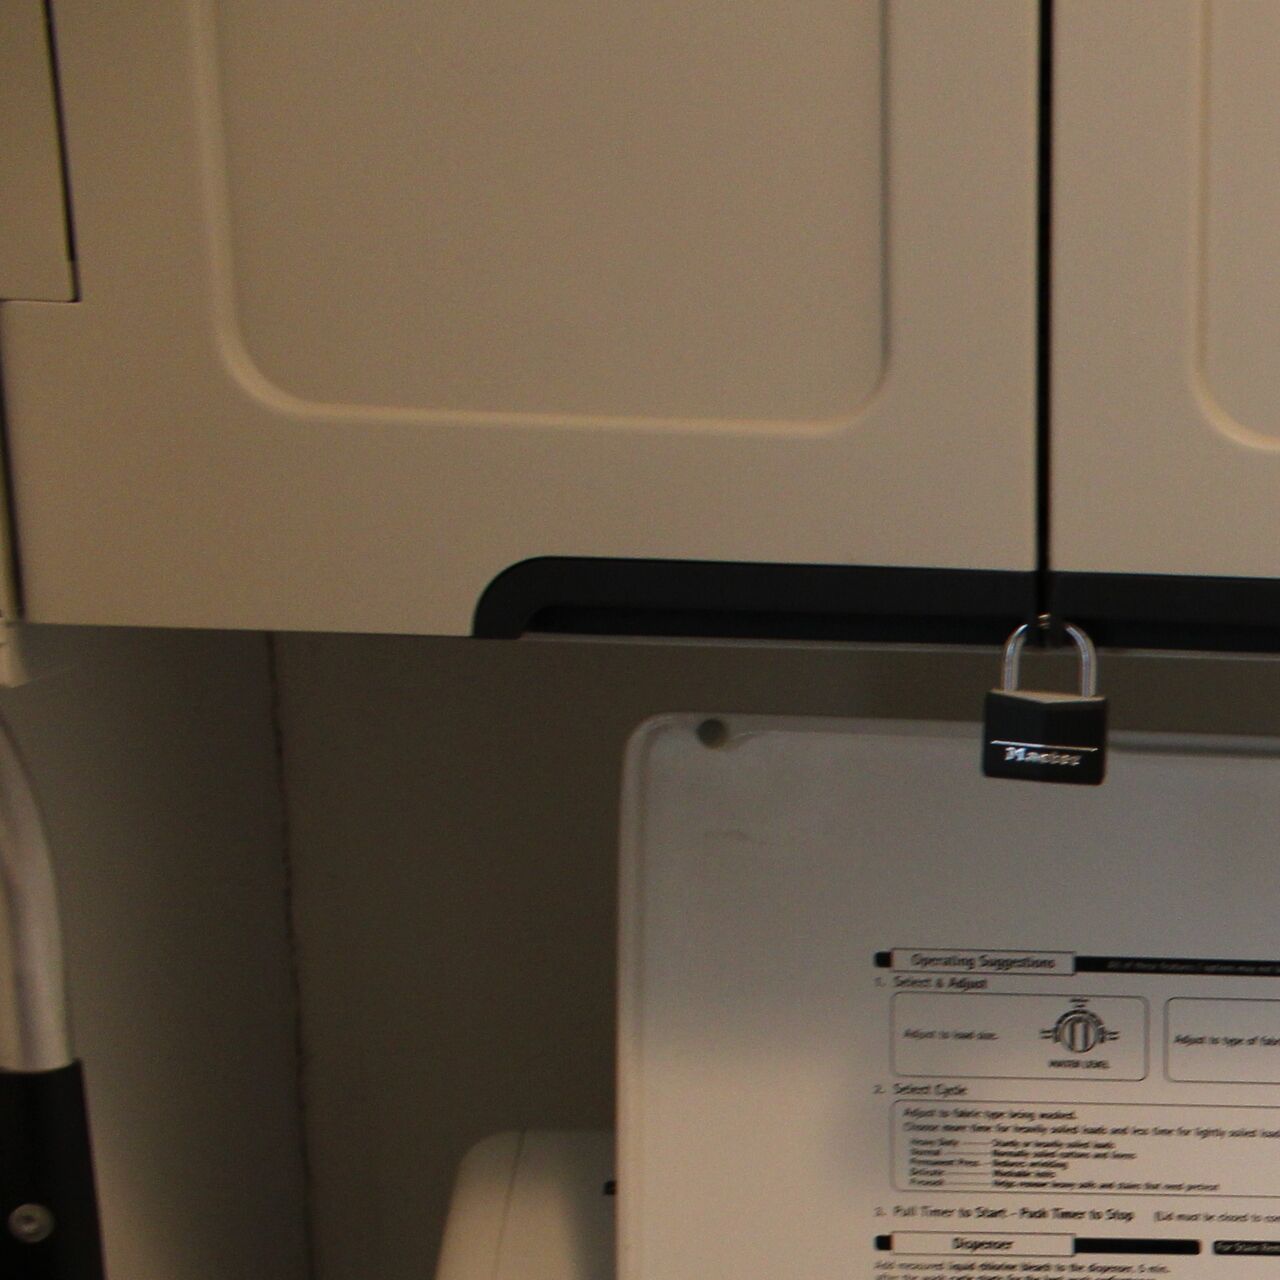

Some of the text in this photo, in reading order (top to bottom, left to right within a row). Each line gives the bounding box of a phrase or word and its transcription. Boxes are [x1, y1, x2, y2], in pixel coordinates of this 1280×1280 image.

[911, 953, 1056, 972] Operating Suggestions
[894, 1083, 930, 1094] Select
[933, 1084, 967, 1098] Cycle
[892, 1203, 916, 1215] Pull
[919, 1203, 955, 1216] Timer
[974, 1204, 1007, 1217] Start
[1018, 1205, 1048, 1217] Push
[1051, 1205, 1085, 1218] Timer
[1105, 1206, 1134, 1222] Stop
[952, 1238, 1014, 1254] Dispenser
